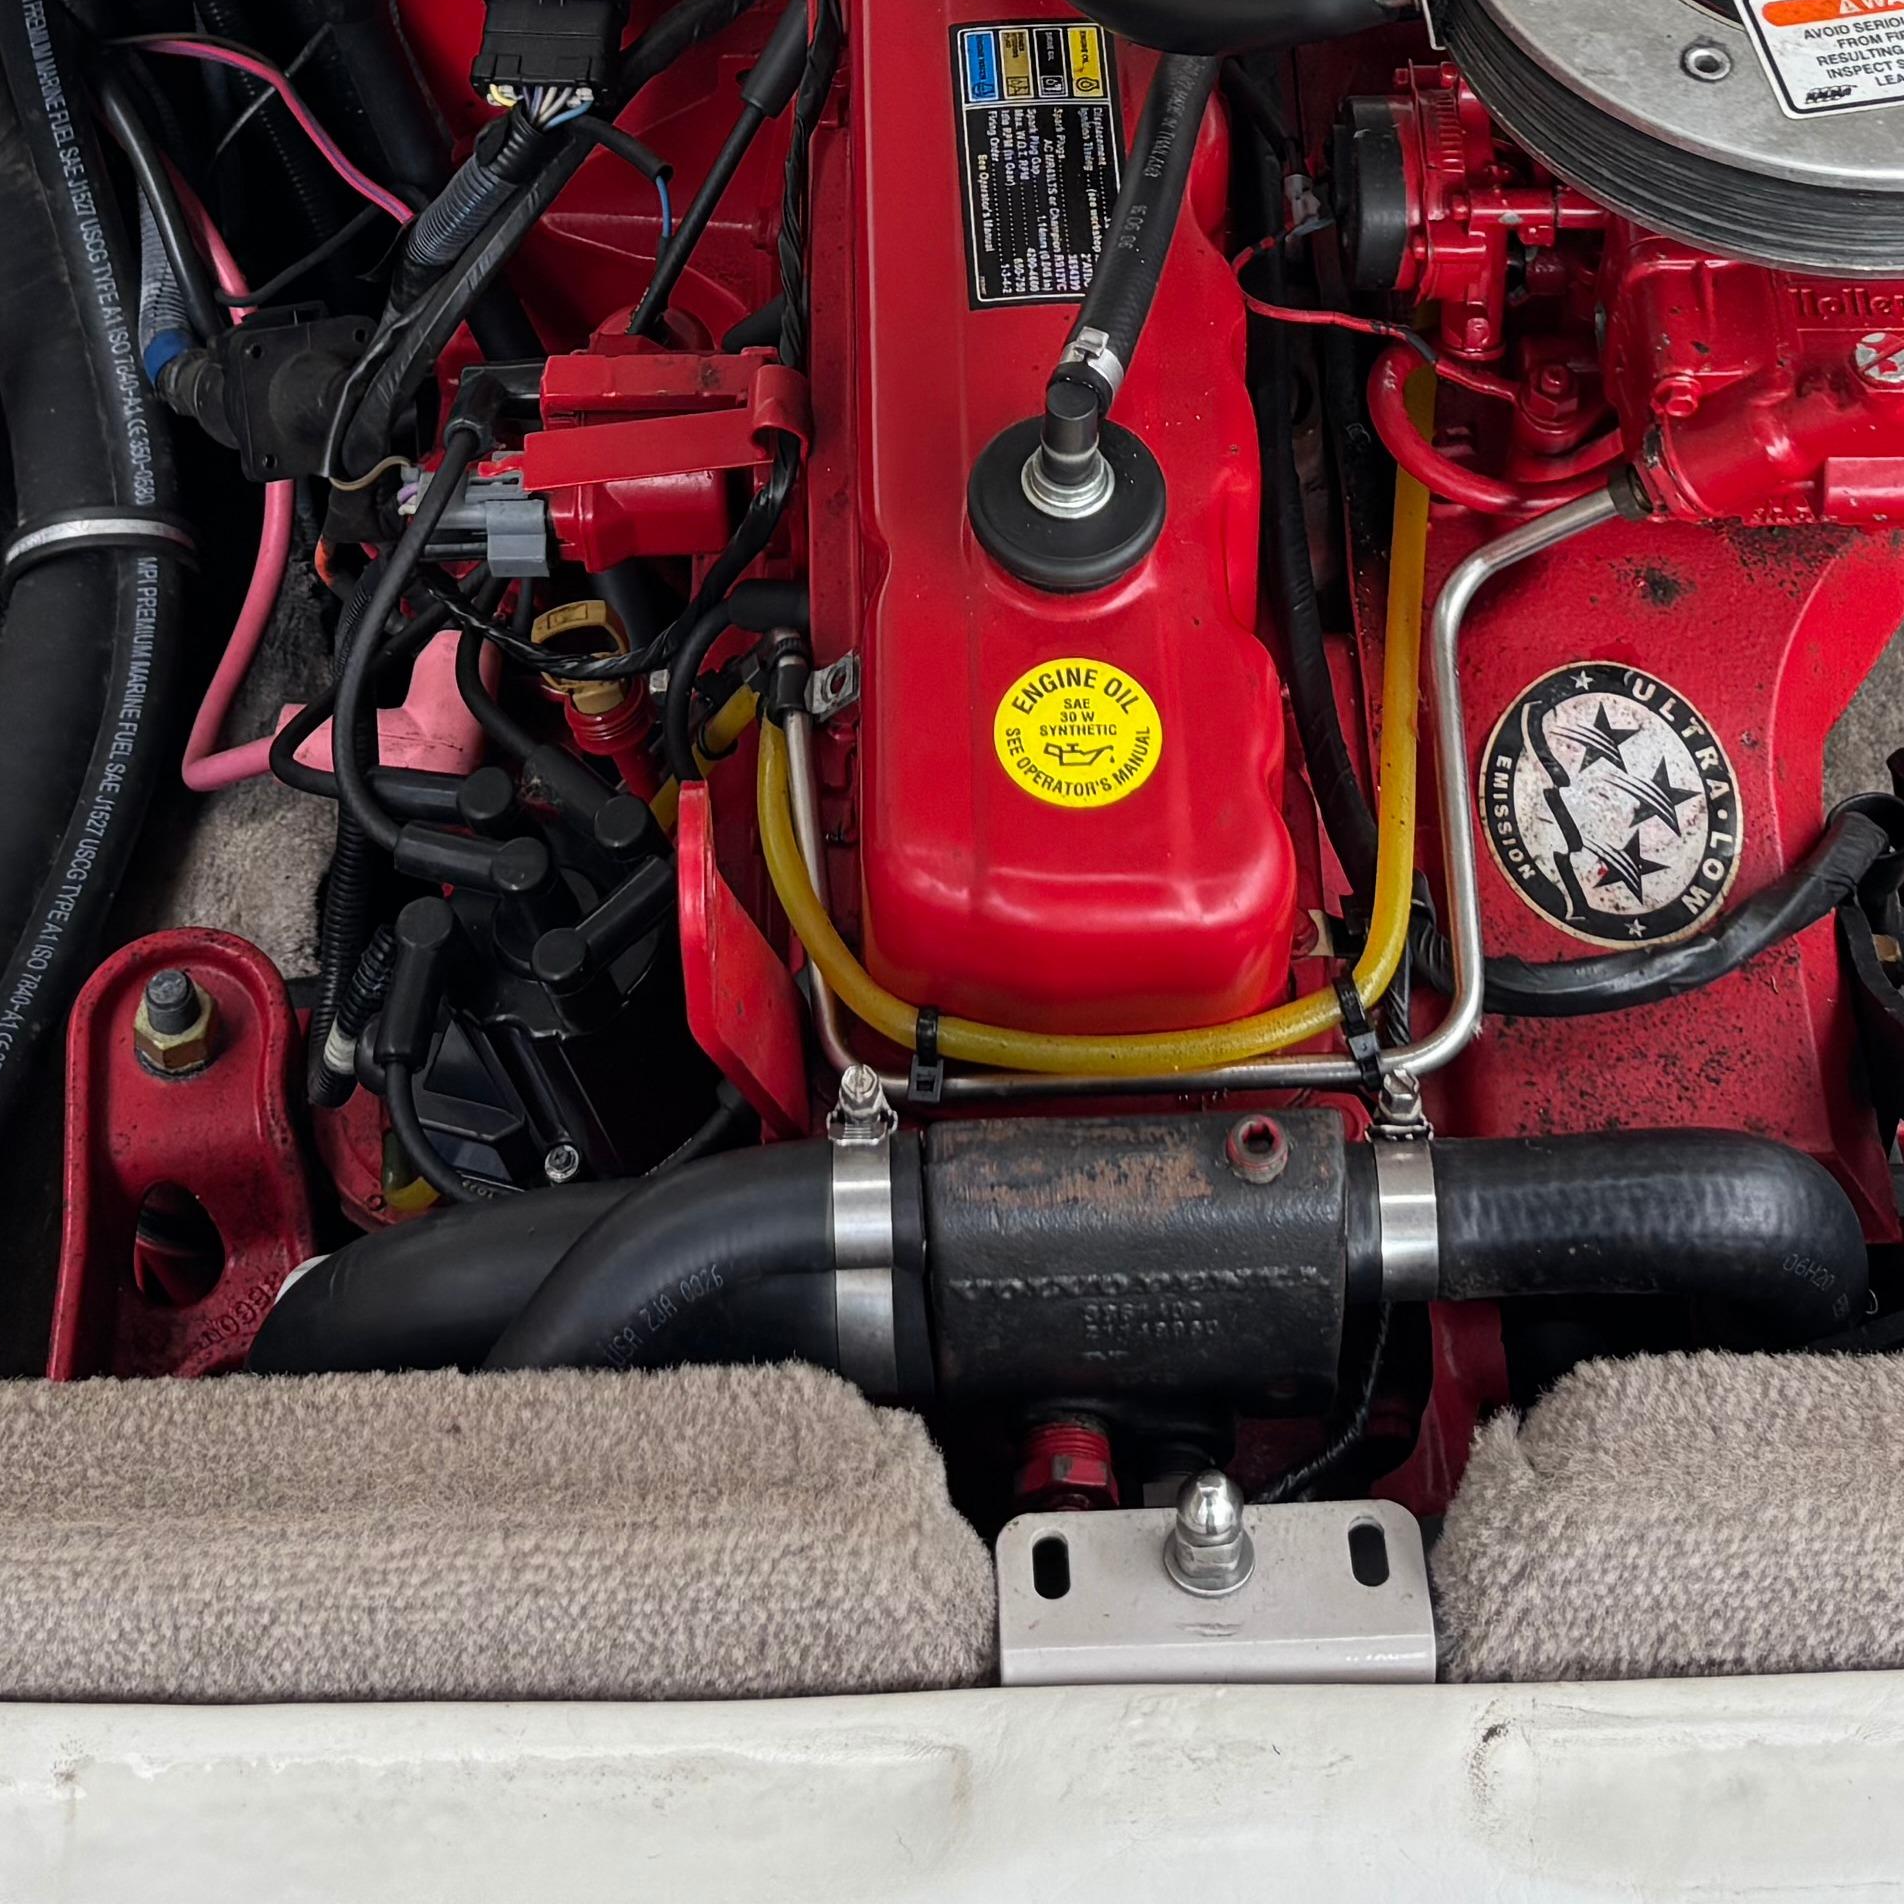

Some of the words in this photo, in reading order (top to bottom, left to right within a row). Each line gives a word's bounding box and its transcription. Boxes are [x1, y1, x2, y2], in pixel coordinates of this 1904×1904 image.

[1803, 23, 1850, 40] AVOID
[1836, 34, 1881, 49] FROM
[1816, 46, 1904, 68] RESULTING
[1827, 59, 1893, 79] INSPECT
[36, 57, 66, 108] MARINE
[48, 109, 74, 147] FUEL
[60, 147, 84, 177] SAE
[67, 180, 96, 216] J1527
[80, 220, 108, 264] USCG
[92, 262, 119, 304] TYPE
[103, 307, 124, 326] A1
[108, 327, 130, 354] ISO
[130, 439, 155, 505] 350-0580
[137, 557, 158, 585] MPI
[131, 587, 157, 658] PREMIUM
[119, 661, 151, 719] MARINE
[1011, 667, 1098, 715] ENGINE
[1103, 677, 1139, 714] OIL
[1064, 698, 1090, 709] SAE
[1040, 724, 1117, 736] SYNTHETIC
[1060, 711, 1076, 722] 30
[1081, 711, 1094, 722] W
[109, 722, 138, 759] FUEL
[99, 763, 126, 792] SAE
[1006, 728, 1024, 756] SEE
[1017, 756, 1112, 796] OPERATOR'S
[1112, 727, 1150, 785] MANUAL
[84, 795, 115, 836] J1527
[1492, 755, 1537, 881] EMISSION
[66, 838, 98, 880] USCG
[47, 884, 82, 921] TYPE
[39, 922, 64, 941] A1
[26, 944, 54, 970] ISO
[0, 973, 42, 1030] 7840-A1
